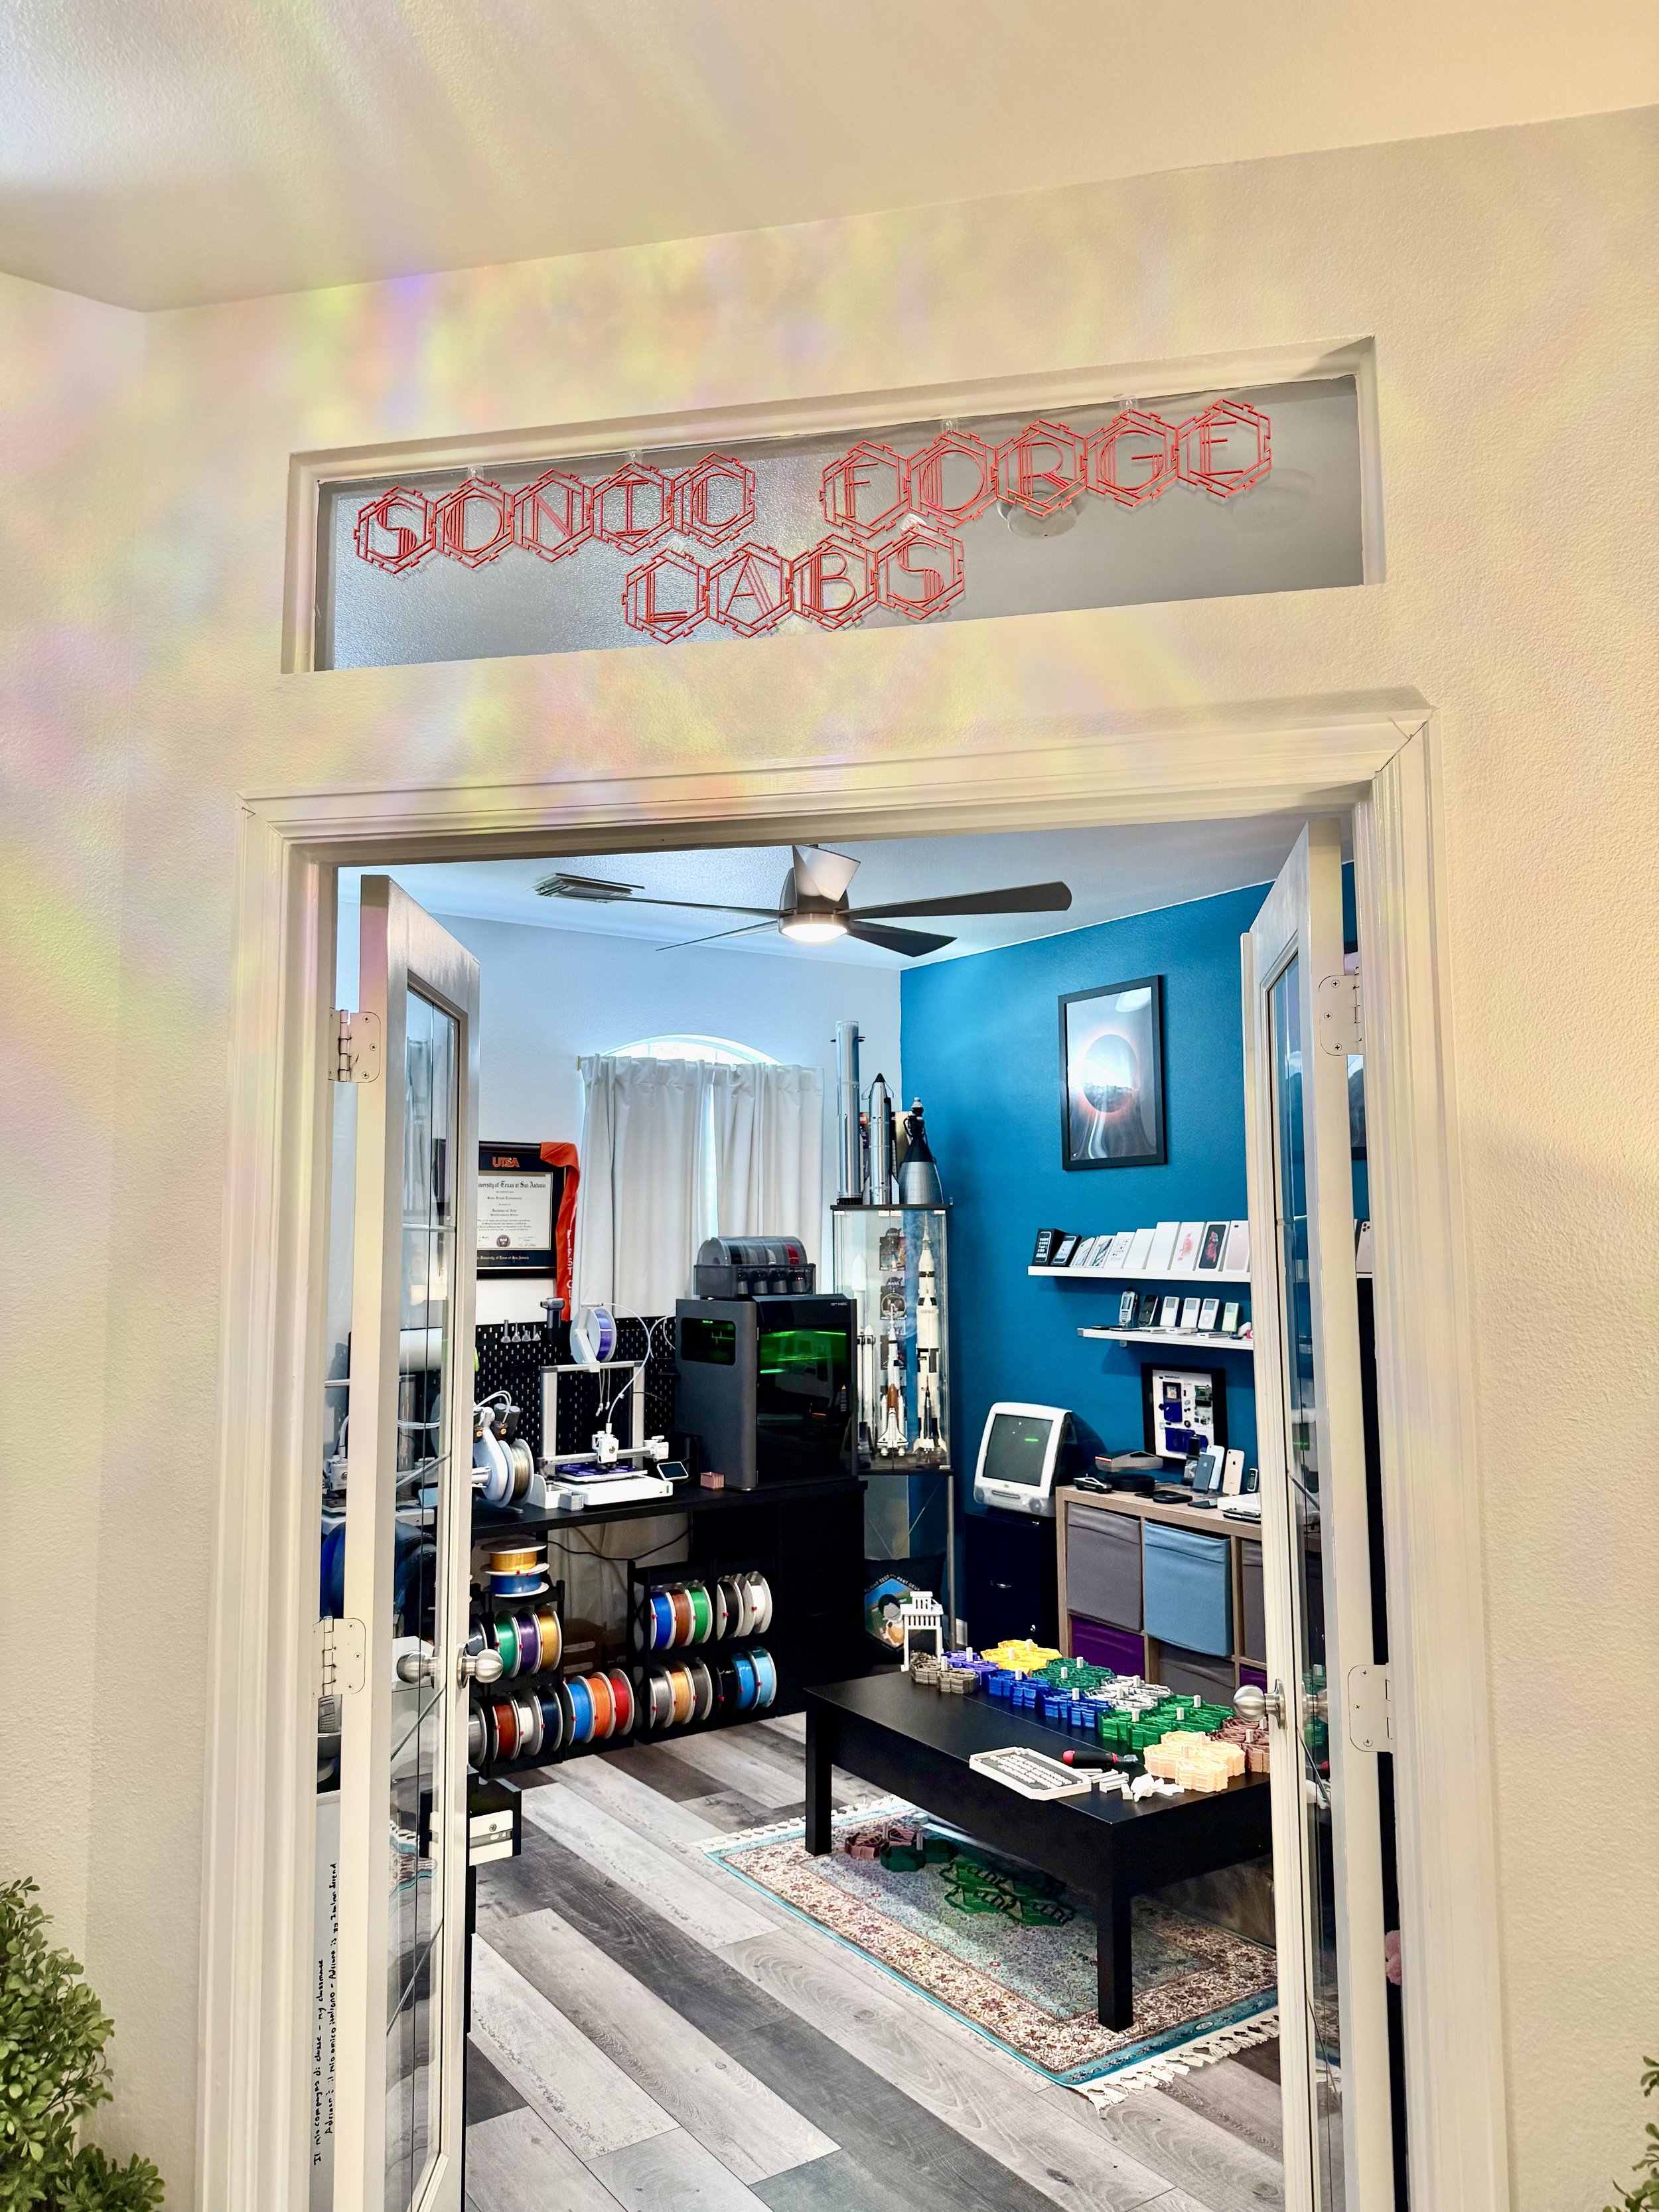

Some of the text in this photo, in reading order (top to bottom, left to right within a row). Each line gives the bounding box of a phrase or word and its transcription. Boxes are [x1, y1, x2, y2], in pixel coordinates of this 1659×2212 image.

[374, 418, 1245, 559] SONIC FORGE
[644, 540, 945, 624] LABS
[492, 1156, 520, 1168] UTSA
